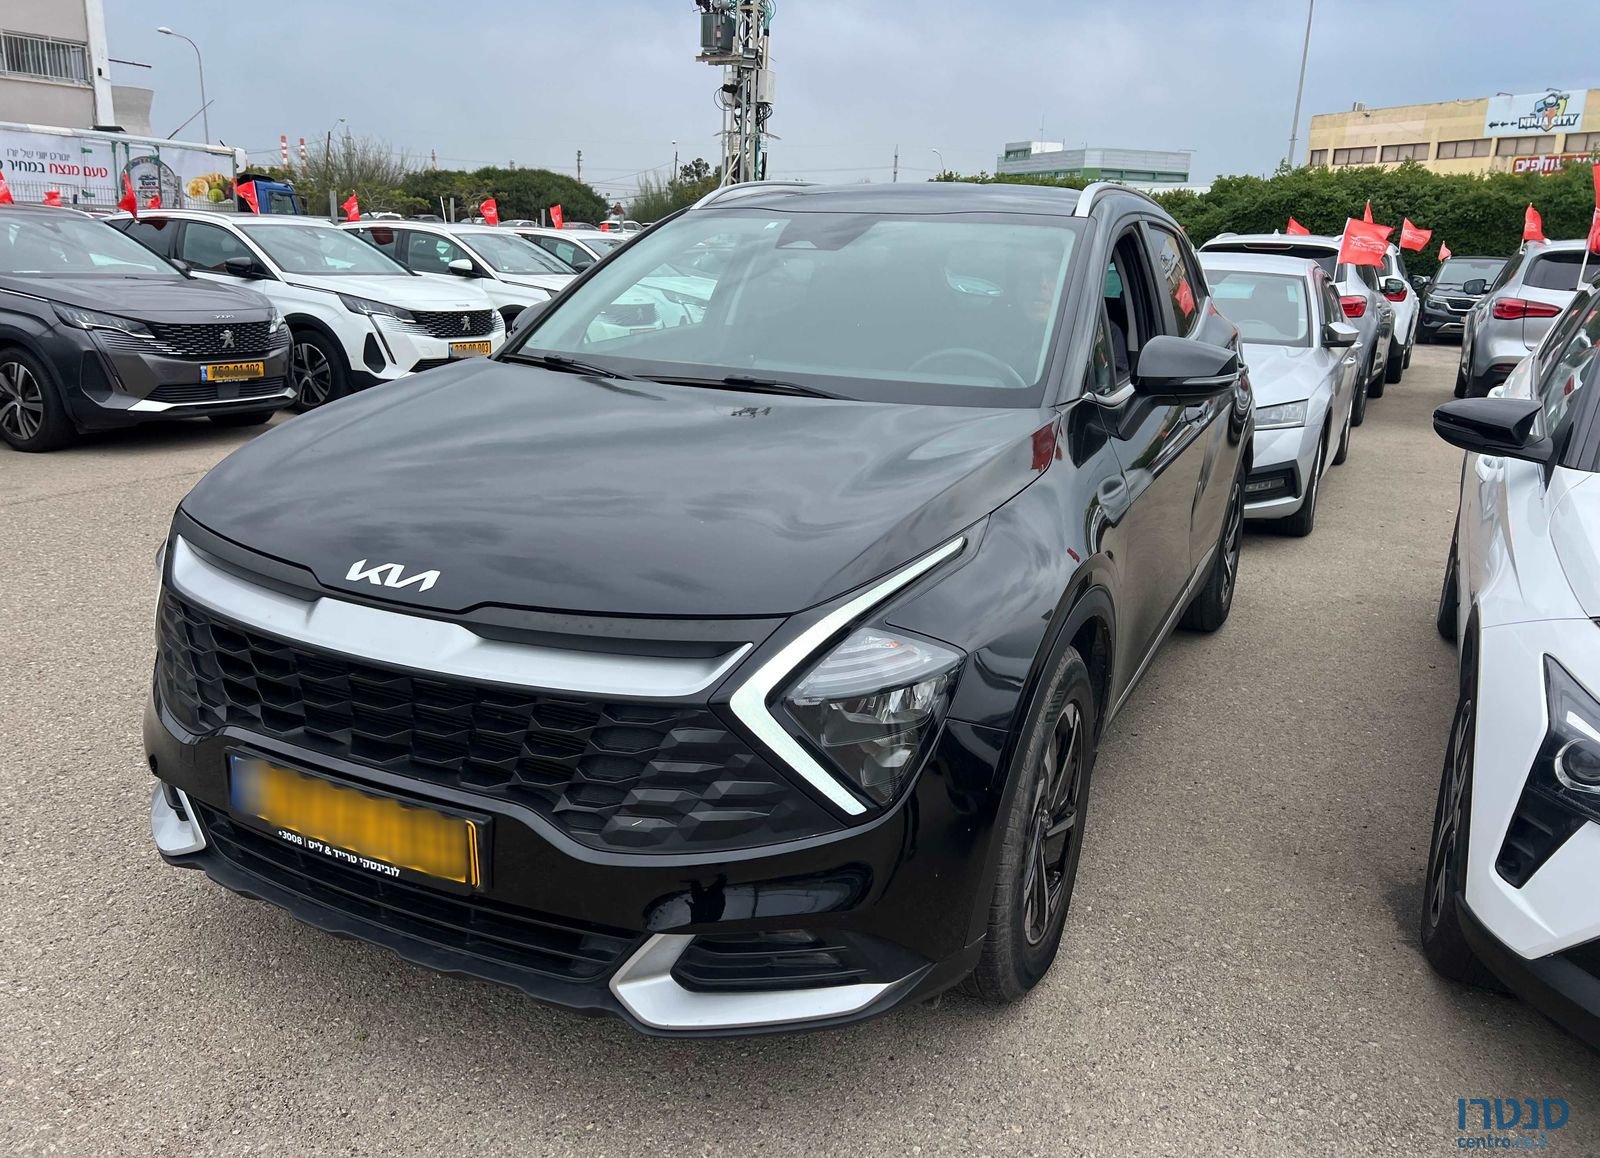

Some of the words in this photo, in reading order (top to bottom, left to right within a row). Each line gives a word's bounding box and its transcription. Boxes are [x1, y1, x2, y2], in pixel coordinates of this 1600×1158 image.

[1519, 116, 1549, 128] NINJA
[1550, 114, 1579, 126] CITY
[20, 148, 34, 158] של
[7, 159, 46, 174] במחיר
[49, 163, 80, 176] מנצח
[83, 166, 108, 178] טעם
[345, 558, 441, 593] KIA
[308, 840, 324, 852] ליס
[324, 846, 332, 856] &
[332, 848, 358, 864] טרייד
[358, 857, 401, 878] לובינסקי
